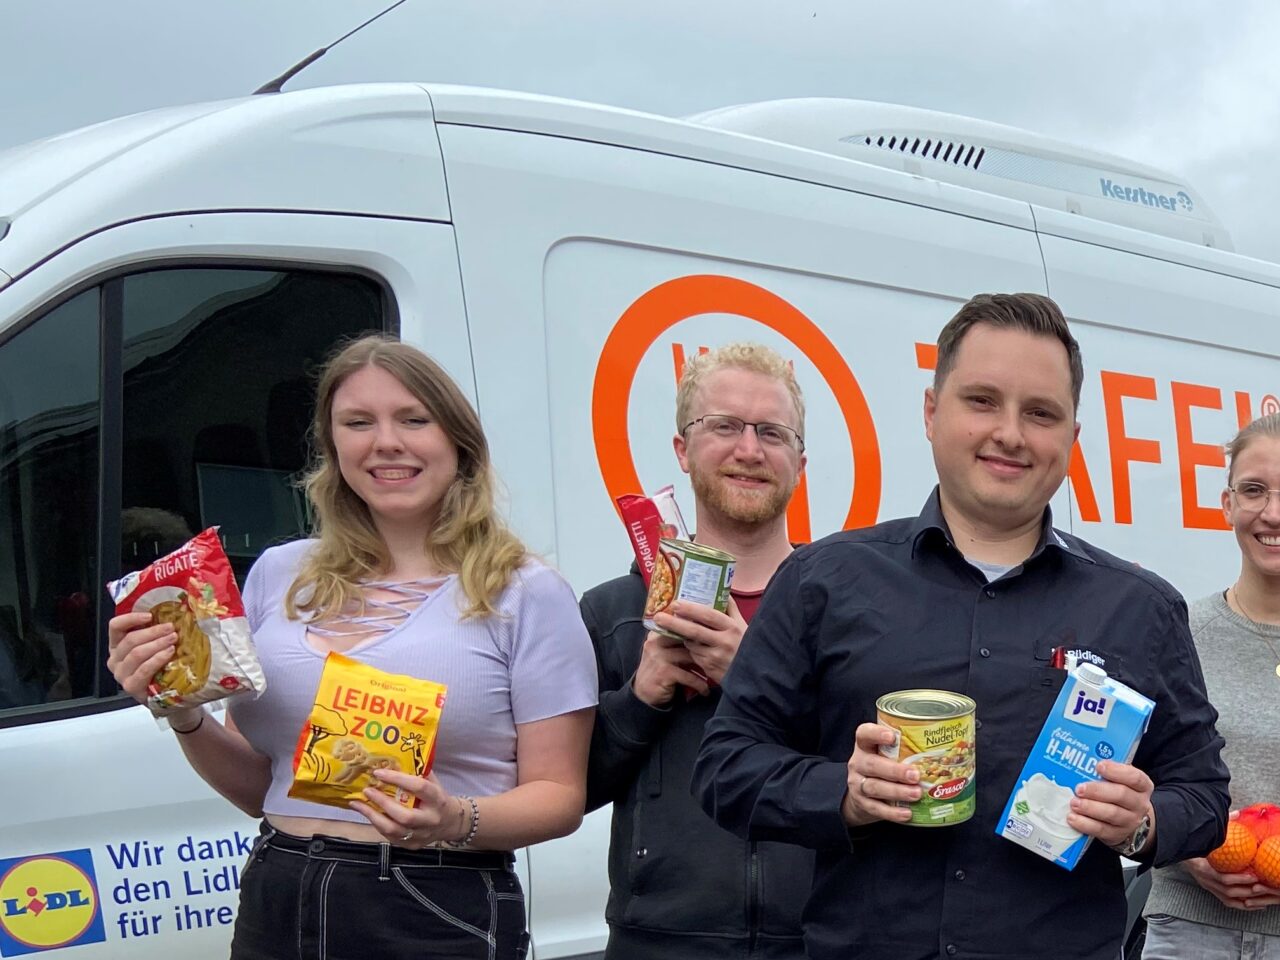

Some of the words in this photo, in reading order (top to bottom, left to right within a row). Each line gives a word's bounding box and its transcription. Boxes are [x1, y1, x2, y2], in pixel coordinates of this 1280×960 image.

[1099, 178, 1178, 212] Kerstner
[154, 552, 200, 582] RIGATE
[332, 685, 429, 727] LEIBNIZ
[1073, 690, 1107, 716] ja!
[350, 716, 401, 746] ZOO
[1045, 738, 1103, 779] H-MILC
[933, 779, 966, 798] Erasco
[106, 840, 164, 870] Wir
[112, 878, 171, 905] den
[183, 865, 241, 896] Lidl
[117, 910, 162, 939] für
[175, 902, 234, 931] ihre
